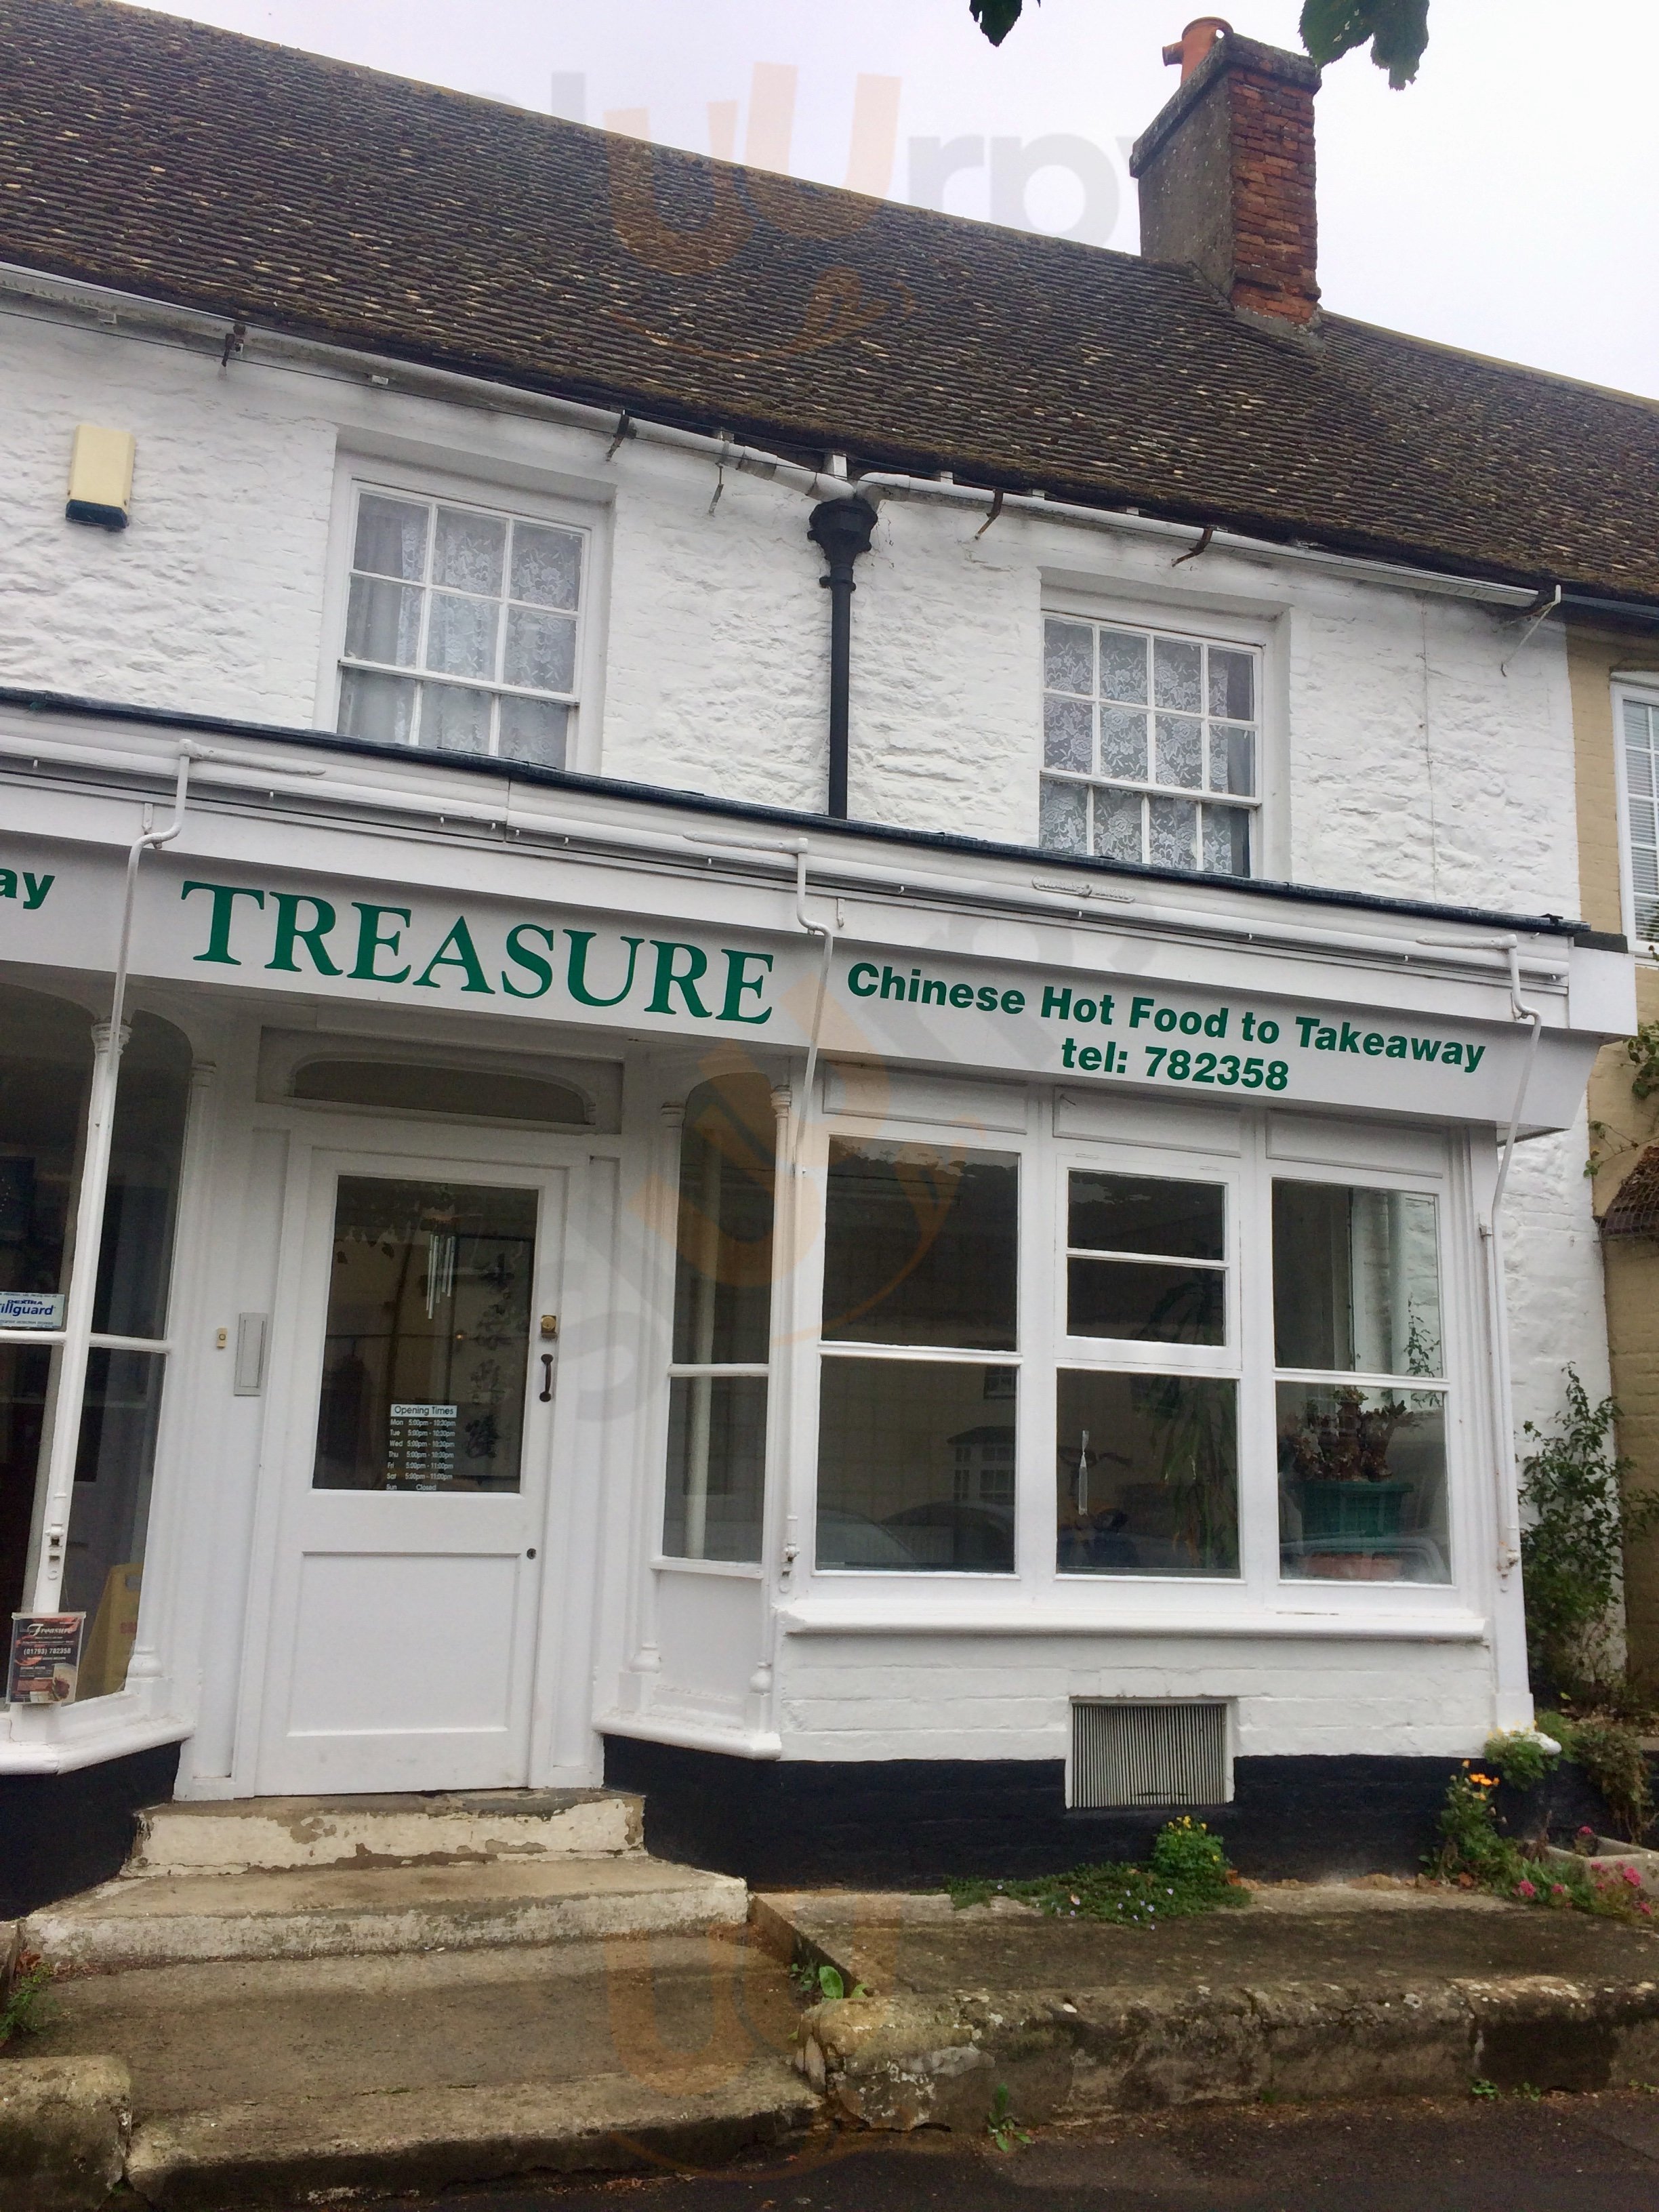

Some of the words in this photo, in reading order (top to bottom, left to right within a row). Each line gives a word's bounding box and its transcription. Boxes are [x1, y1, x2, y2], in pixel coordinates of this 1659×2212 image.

[180, 880, 774, 1025] TREASURE
[846, 962, 1025, 1015] Chinese
[1041, 986, 1114, 1025] Hot
[1129, 996, 1228, 1039] Food
[1242, 1012, 1280, 1044] to
[1295, 1017, 1486, 1073] Takeaway
[1061, 1037, 1128, 1073] tel:
[1145, 1046, 1290, 1091] 782358
[0, 1304, 54, 1317] illguard
[394, 1406, 429, 1416] Opening
[432, 1406, 453, 1414] Times
